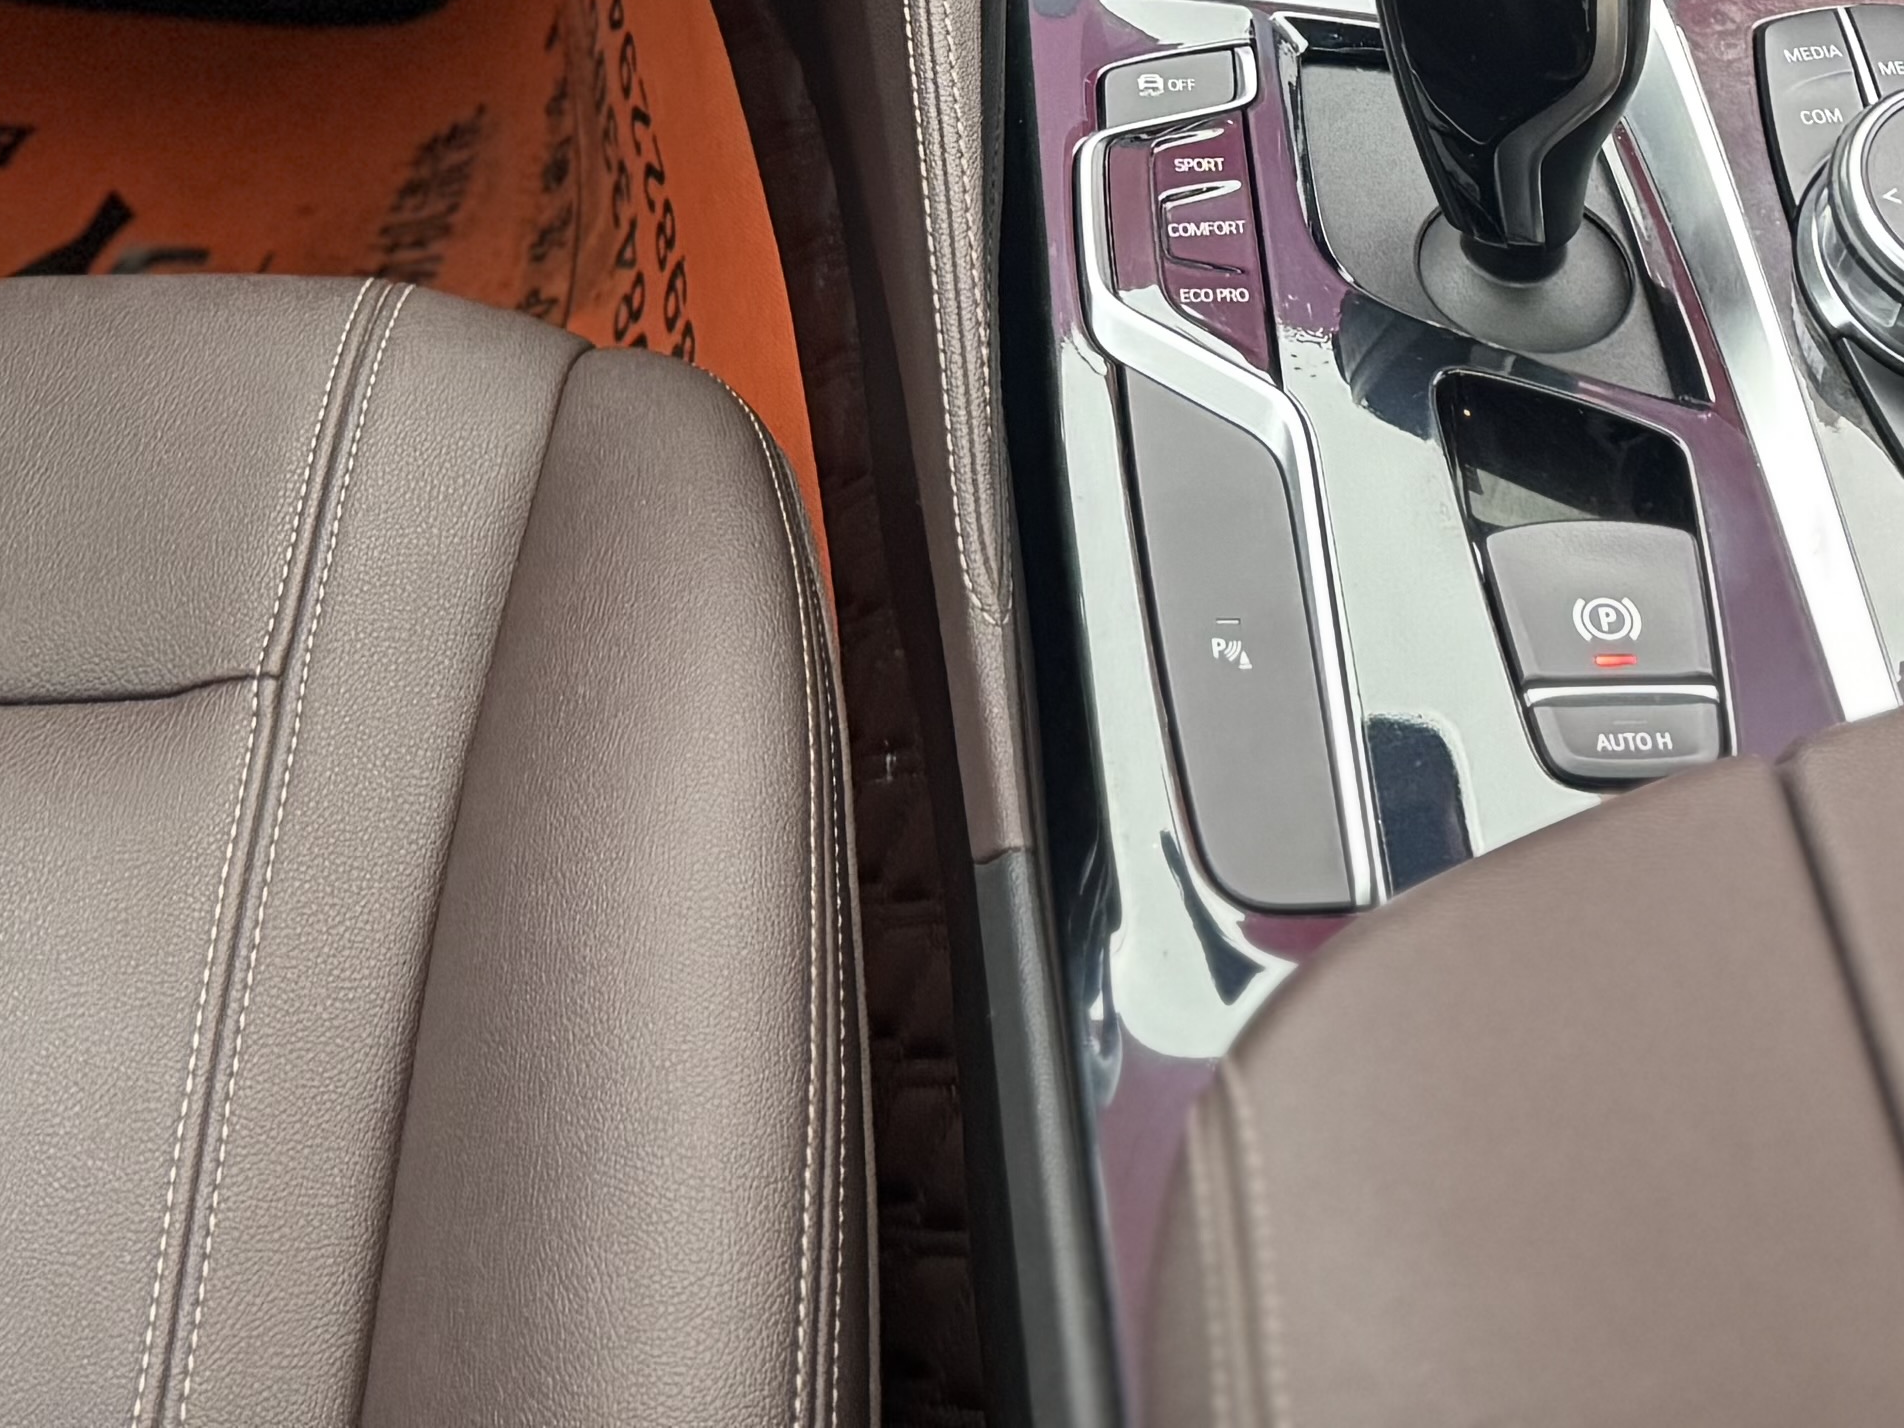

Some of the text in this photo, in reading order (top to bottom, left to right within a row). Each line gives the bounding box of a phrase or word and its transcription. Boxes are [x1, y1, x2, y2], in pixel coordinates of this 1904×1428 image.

[1783, 43, 1844, 63] MEDIA
[1167, 78, 1197, 92] OFF
[1799, 107, 1844, 126] COM
[1174, 157, 1225, 173] SPORT
[1167, 219, 1246, 238] COMFORT
[1179, 287, 1250, 304] ECO PRO
[1596, 731, 1674, 753] AUTO H
